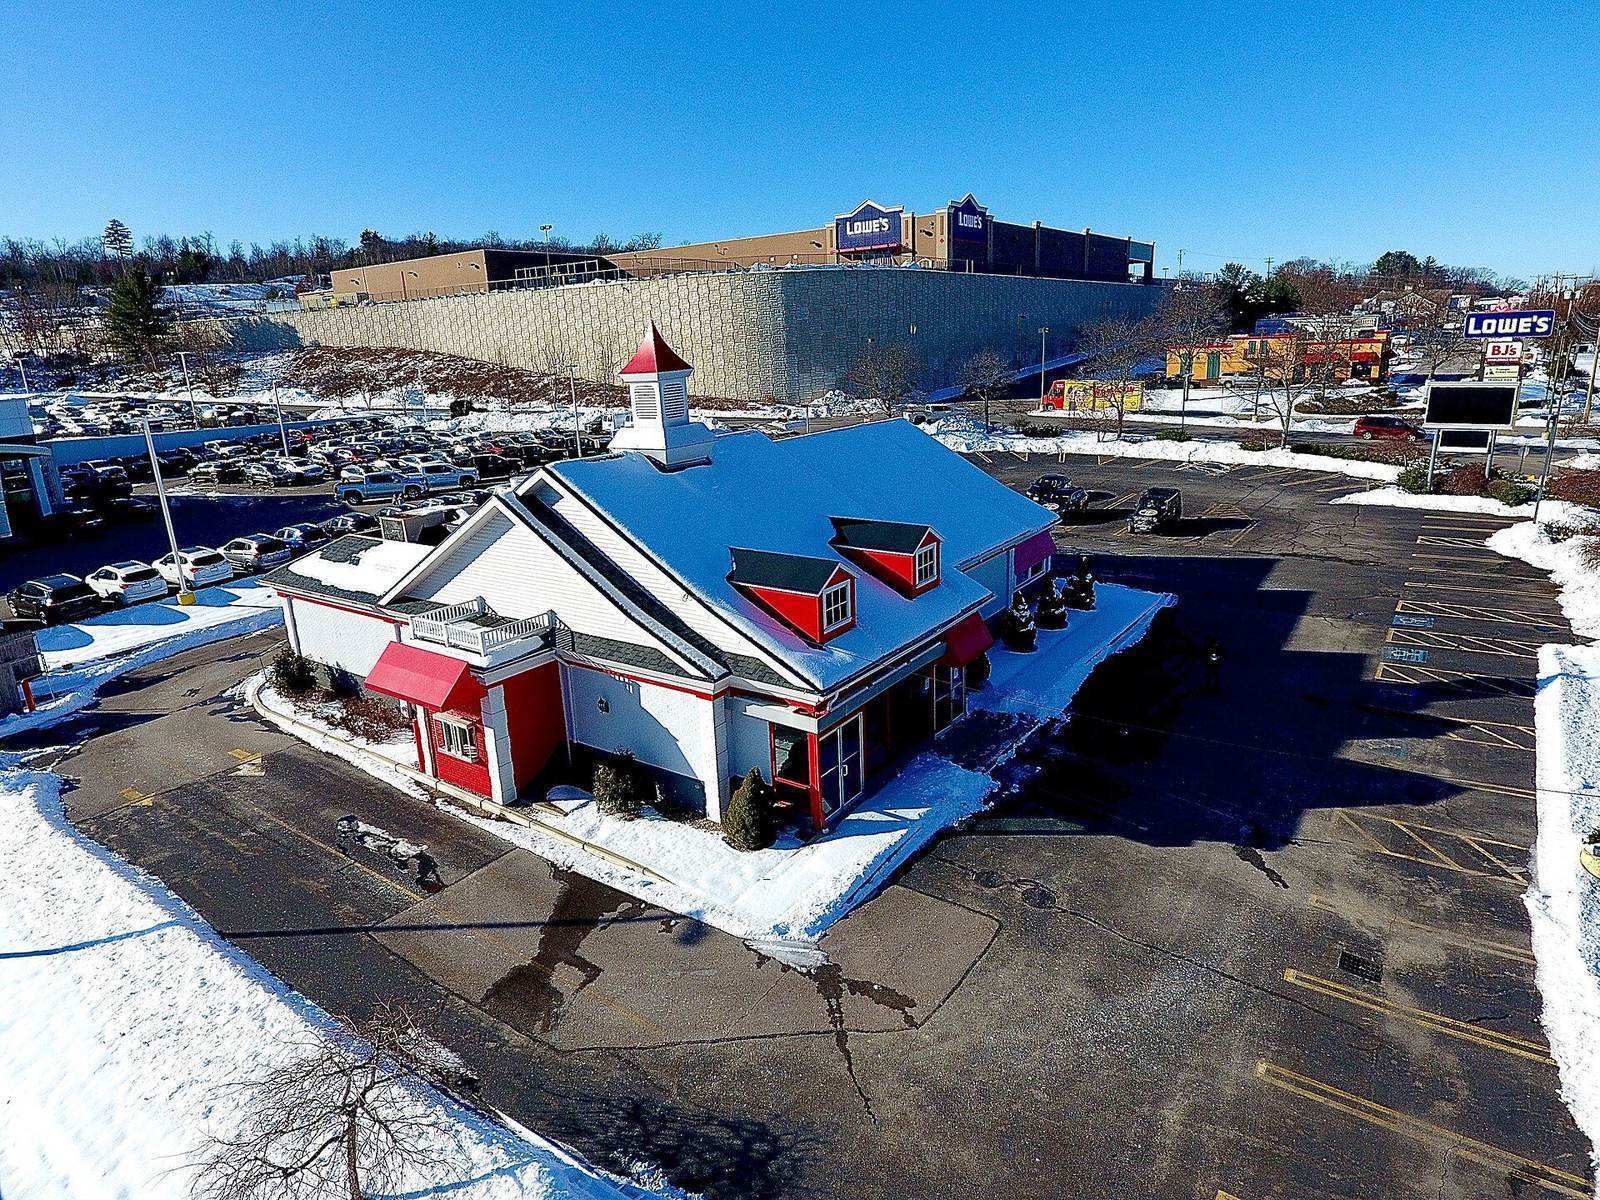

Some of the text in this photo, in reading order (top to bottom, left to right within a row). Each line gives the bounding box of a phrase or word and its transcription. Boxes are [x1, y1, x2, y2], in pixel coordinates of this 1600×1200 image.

[846, 217, 890, 236] LOWE'S
[958, 211, 982, 229] LOWE'S
[1467, 315, 1549, 334] LOWE'S
[1491, 344, 1517, 356] BJ's
